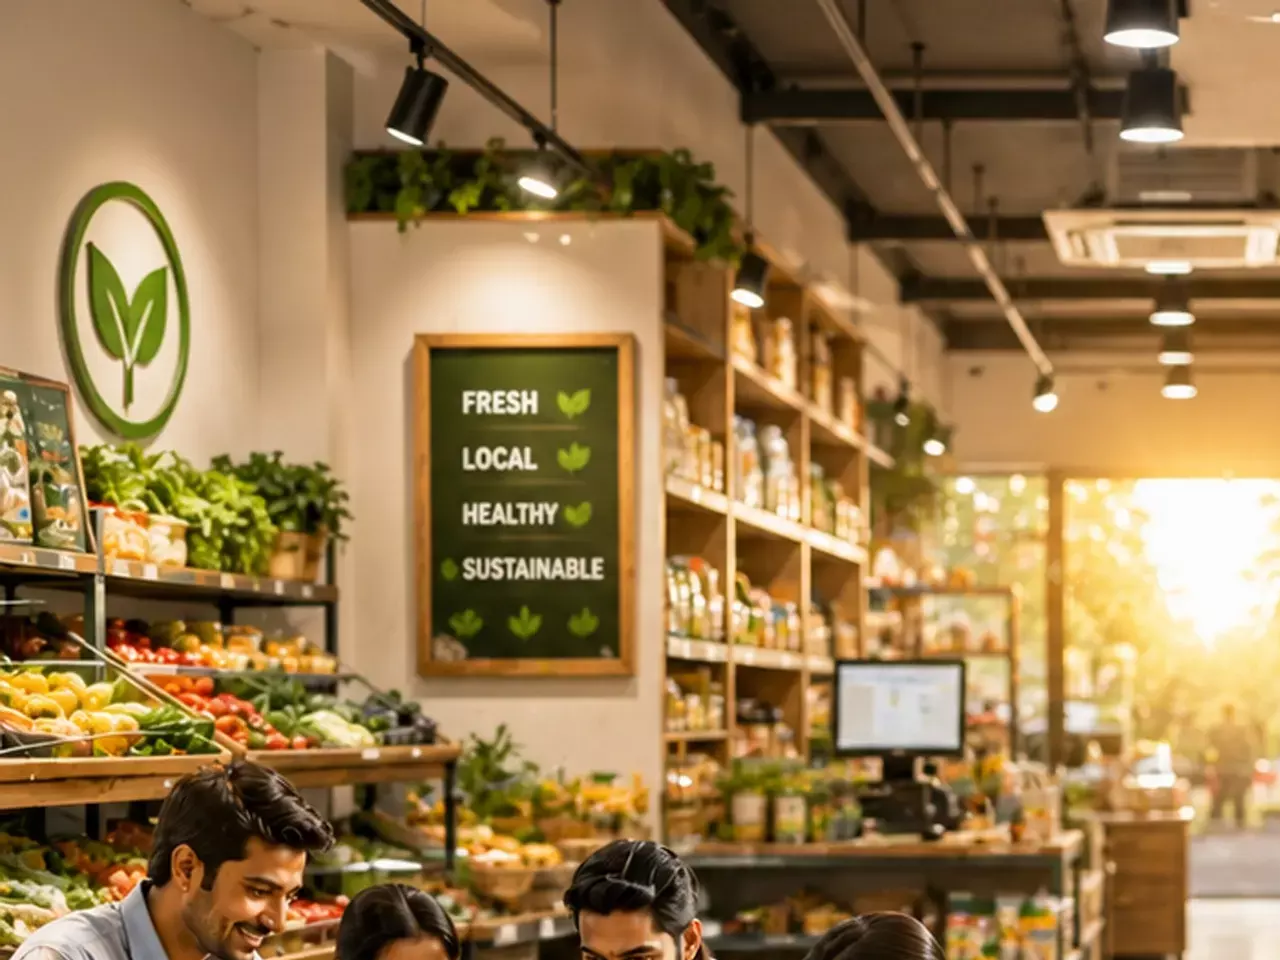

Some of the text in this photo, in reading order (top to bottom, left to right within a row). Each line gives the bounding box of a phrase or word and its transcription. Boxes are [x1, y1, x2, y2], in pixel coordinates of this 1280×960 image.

[462, 389, 539, 415] FRESH
[462, 446, 539, 471] LOCAL
[462, 502, 559, 526] HEALTHY
[462, 557, 605, 581] SUSTAINABLE
